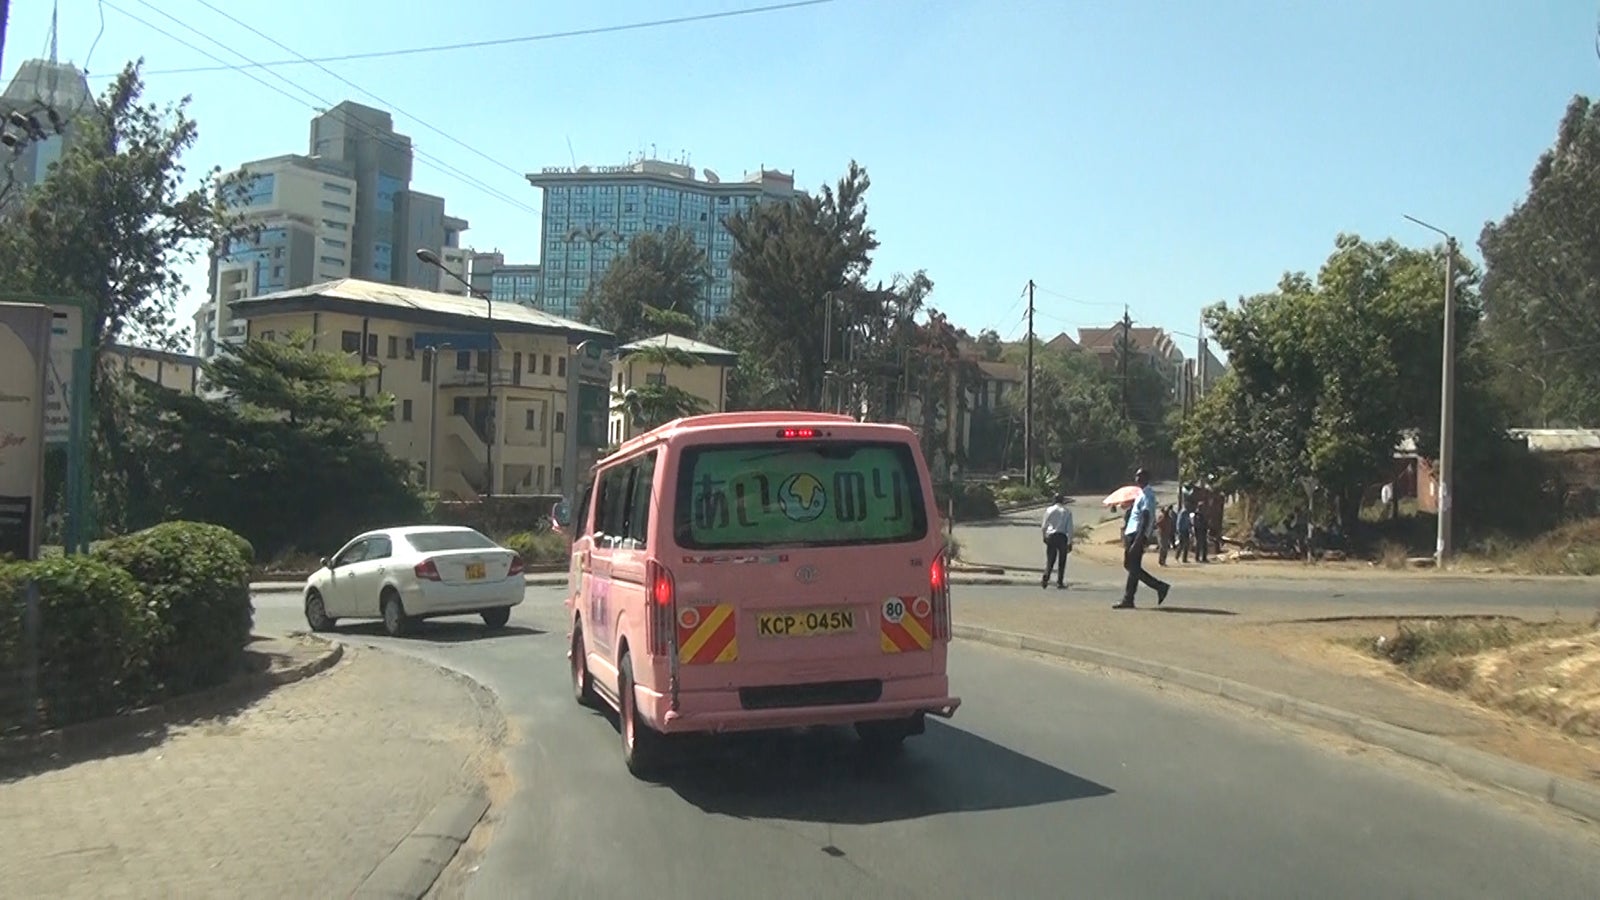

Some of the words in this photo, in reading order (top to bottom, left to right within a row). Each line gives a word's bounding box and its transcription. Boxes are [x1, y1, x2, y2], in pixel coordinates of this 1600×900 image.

[886, 602, 903, 617] 80
[760, 617, 796, 635] KCP
[806, 612, 853, 629] 045N
